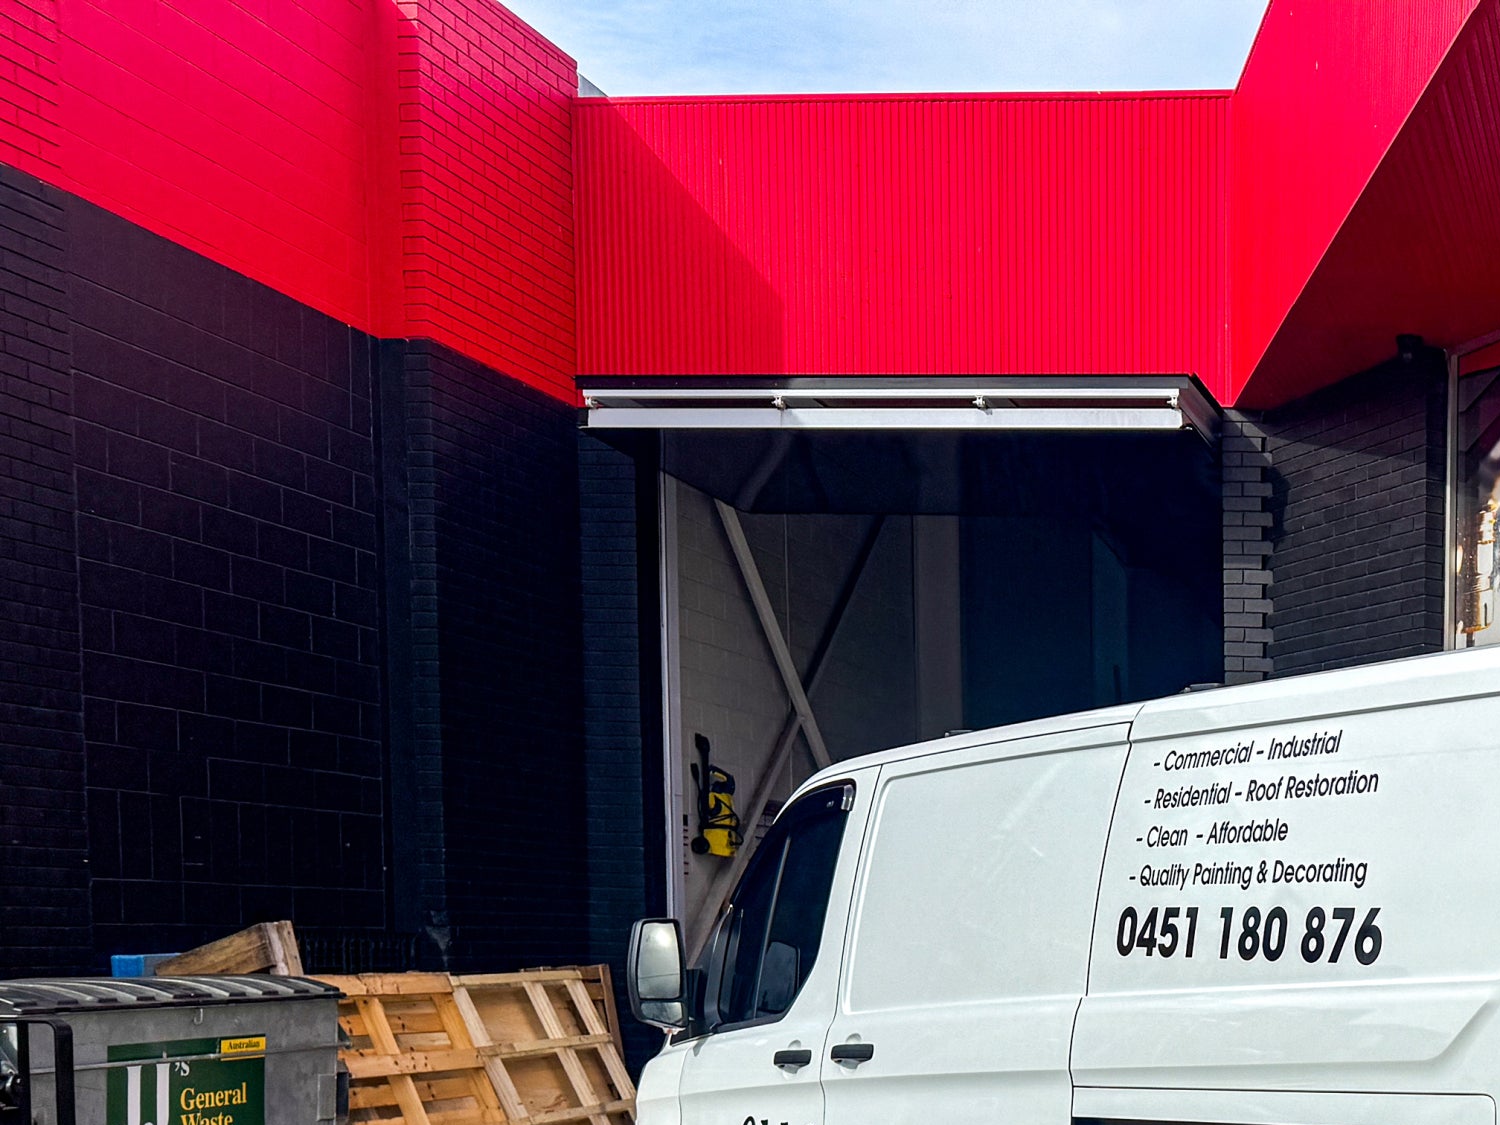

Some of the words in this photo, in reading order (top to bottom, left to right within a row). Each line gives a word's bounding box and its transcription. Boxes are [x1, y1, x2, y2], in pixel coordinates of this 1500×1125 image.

[1164, 740, 1255, 772] Commercial
[1267, 730, 1343, 760] Industrial
[1153, 781, 1232, 809] Residential
[1246, 775, 1284, 802] Roof
[1284, 770, 1379, 800] Restoration
[1146, 825, 1188, 848] Clean
[1206, 818, 1289, 845] Affordable
[1140, 862, 1190, 891] Quality
[1192, 861, 1253, 890] Painting
[1256, 860, 1267, 884] &
[1272, 857, 1368, 889] Decorating
[1116, 906, 1199, 958] 0451
[1219, 906, 1288, 962] 180
[1300, 906, 1383, 966] 876
[227, 1040, 260, 1050] Australian
[180, 1082, 247, 1111] General
